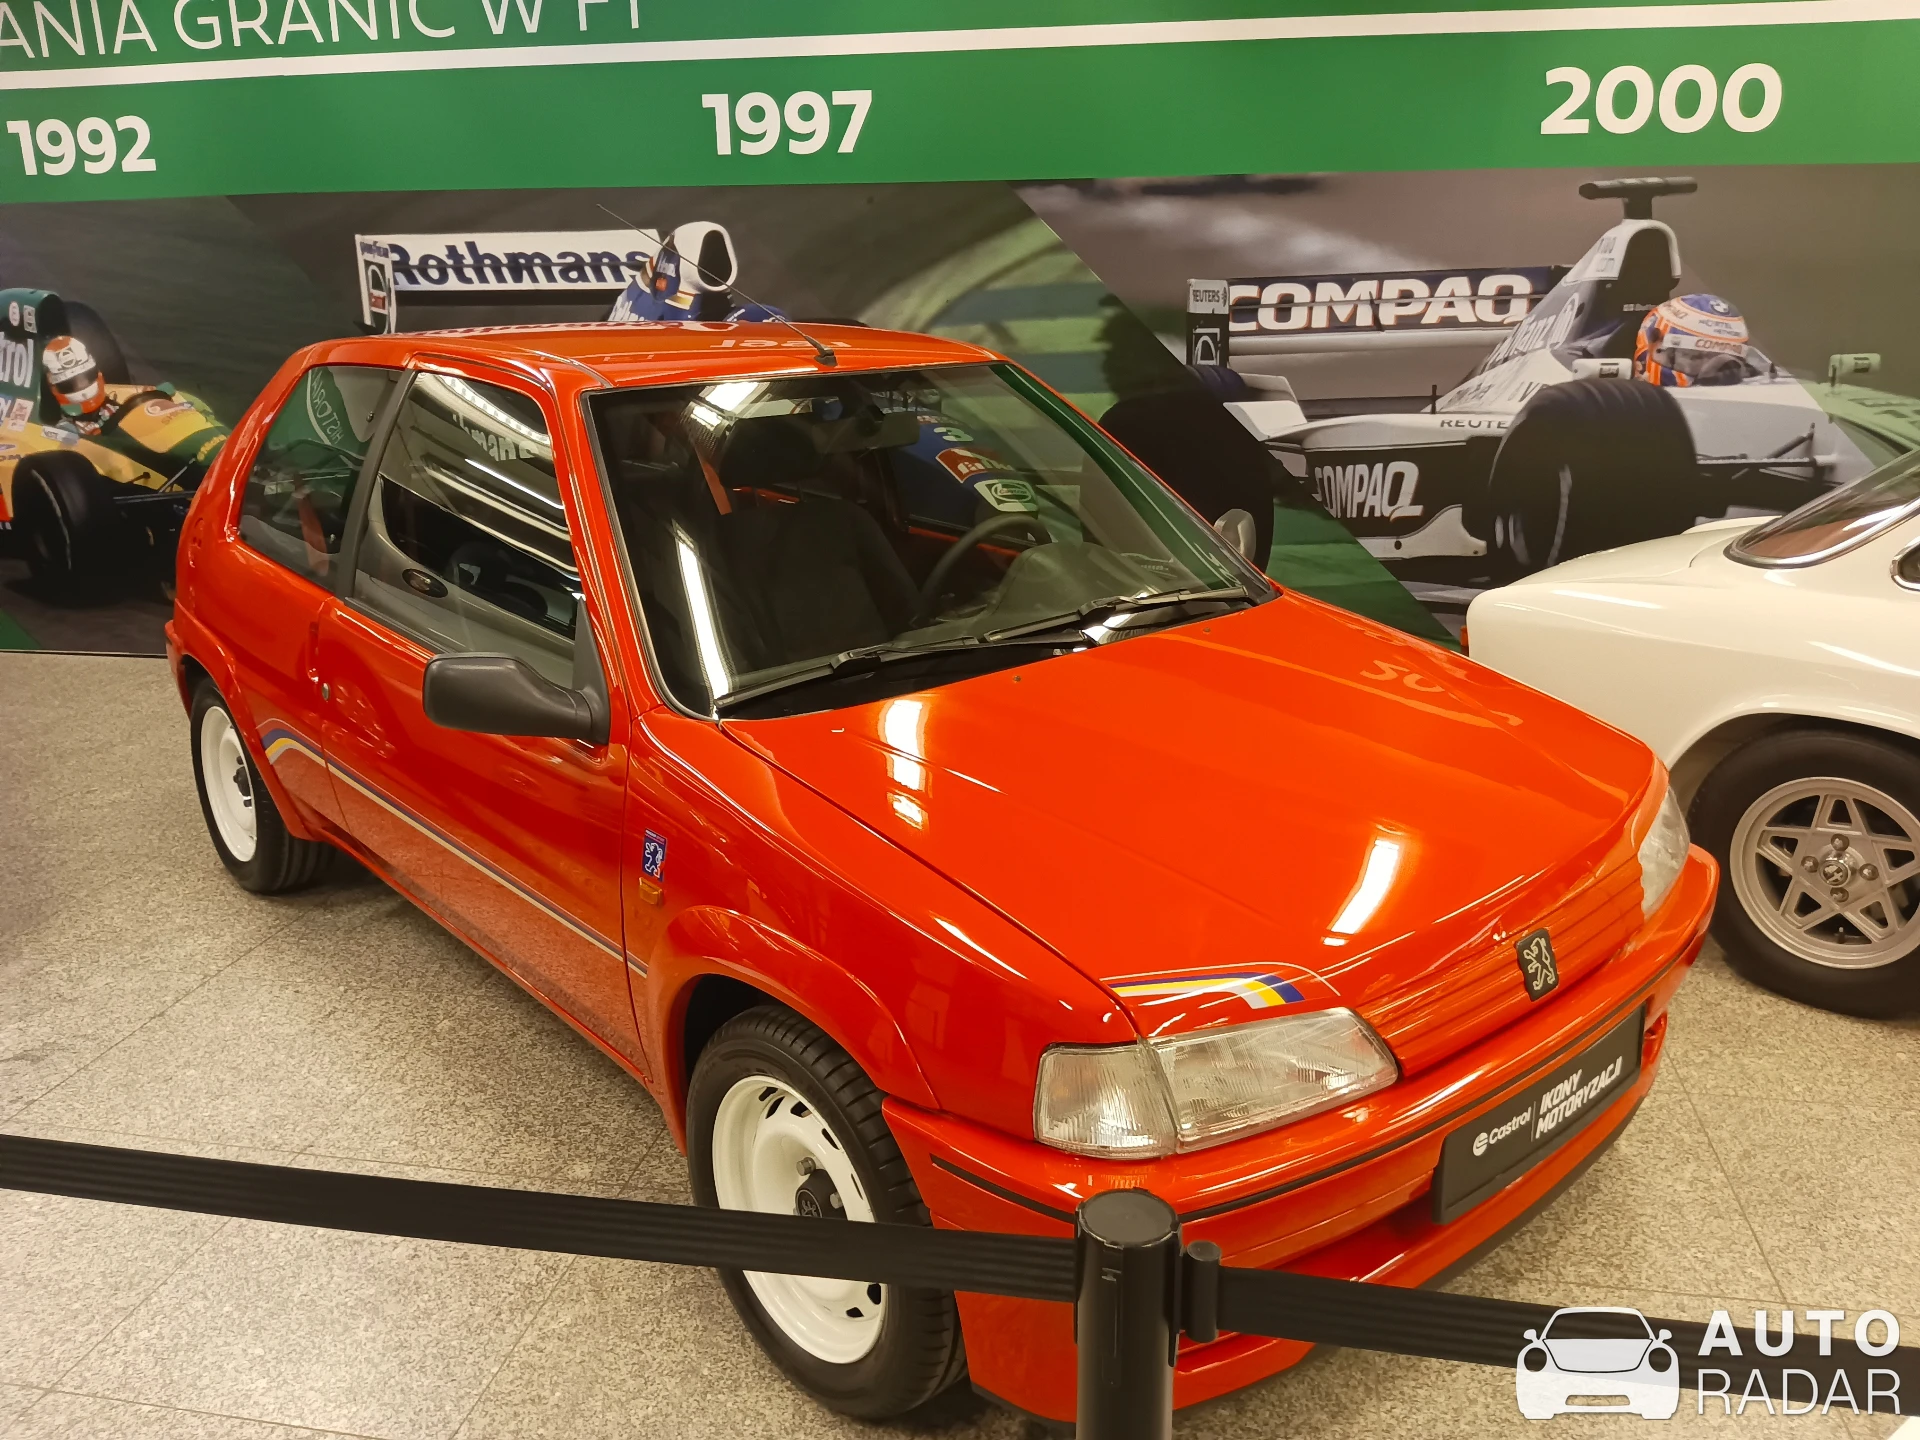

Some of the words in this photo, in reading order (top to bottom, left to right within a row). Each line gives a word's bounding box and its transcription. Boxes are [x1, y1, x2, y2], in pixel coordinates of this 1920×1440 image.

[173, 0, 456, 50] GRANIC
[481, 0, 543, 35] W
[701, 89, 874, 157] 1997
[1540, 63, 1785, 136] 2000
[7, 116, 157, 177] 1992
[388, 241, 652, 286] Rothmans
[1192, 289, 1220, 303] REUTERS
[1228, 274, 1534, 332] COMPAQ
[1440, 419, 1509, 430] REUTE
[1311, 460, 1424, 523] COMPAQ
[1535, 1055, 1623, 1139] MOTORYZACJI
[1539, 1068, 1582, 1115] IKONY
[1489, 1106, 1532, 1144] Castrol
